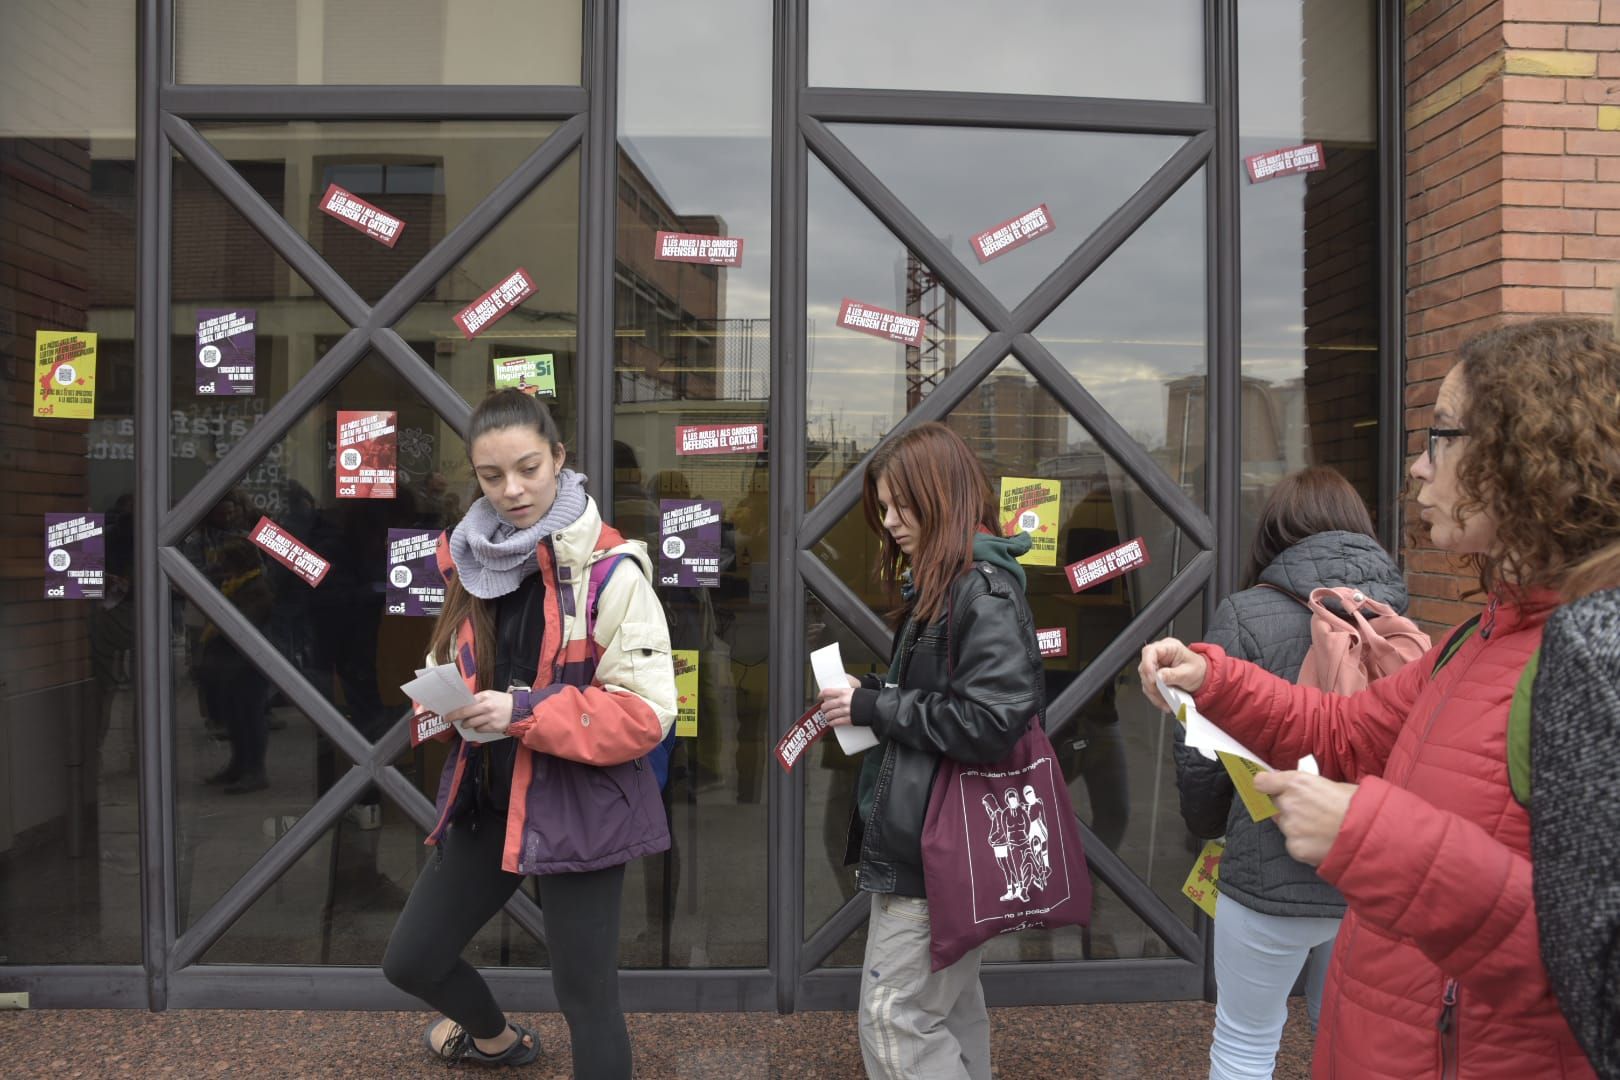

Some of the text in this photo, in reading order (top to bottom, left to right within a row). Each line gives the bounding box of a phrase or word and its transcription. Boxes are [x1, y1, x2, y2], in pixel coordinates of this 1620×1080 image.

[326, 200, 362, 222] DEFENSEM
[359, 214, 370, 225] EL
[336, 195, 348, 206] LES
[363, 207, 376, 218] ALS
[668, 238, 679, 247] LES
[700, 239, 711, 247] ALS
[983, 232, 1016, 256] DEFENSEM
[1013, 228, 1023, 240] EL
[984, 235, 995, 246] LES
[1009, 220, 1021, 231] ALS
[662, 247, 698, 257] DEFENSEM
[699, 247, 707, 257] EL
[467, 310, 479, 322] LES
[491, 289, 503, 302] ALS
[467, 303, 499, 333] DEFENSEM
[495, 298, 506, 310] EL
[852, 308, 863, 317] LES
[882, 314, 894, 323] ALS
[844, 314, 881, 330] DEFENSEM
[880, 321, 889, 331] EL
[536, 360, 551, 376] Sí
[683, 438, 719, 451] DEFENSEM
[720, 437, 727, 448] EL
[688, 431, 698, 440] LES
[720, 428, 730, 438] ALS
[256, 532, 290, 558] DEFENSEM
[286, 551, 297, 562] EL
[266, 529, 278, 540] LES
[292, 545, 304, 556] ALS
[1076, 564, 1109, 587] DEFENSEM
[1107, 561, 1117, 572] EL
[1078, 565, 1089, 576] LES
[1105, 552, 1116, 563] ALS
